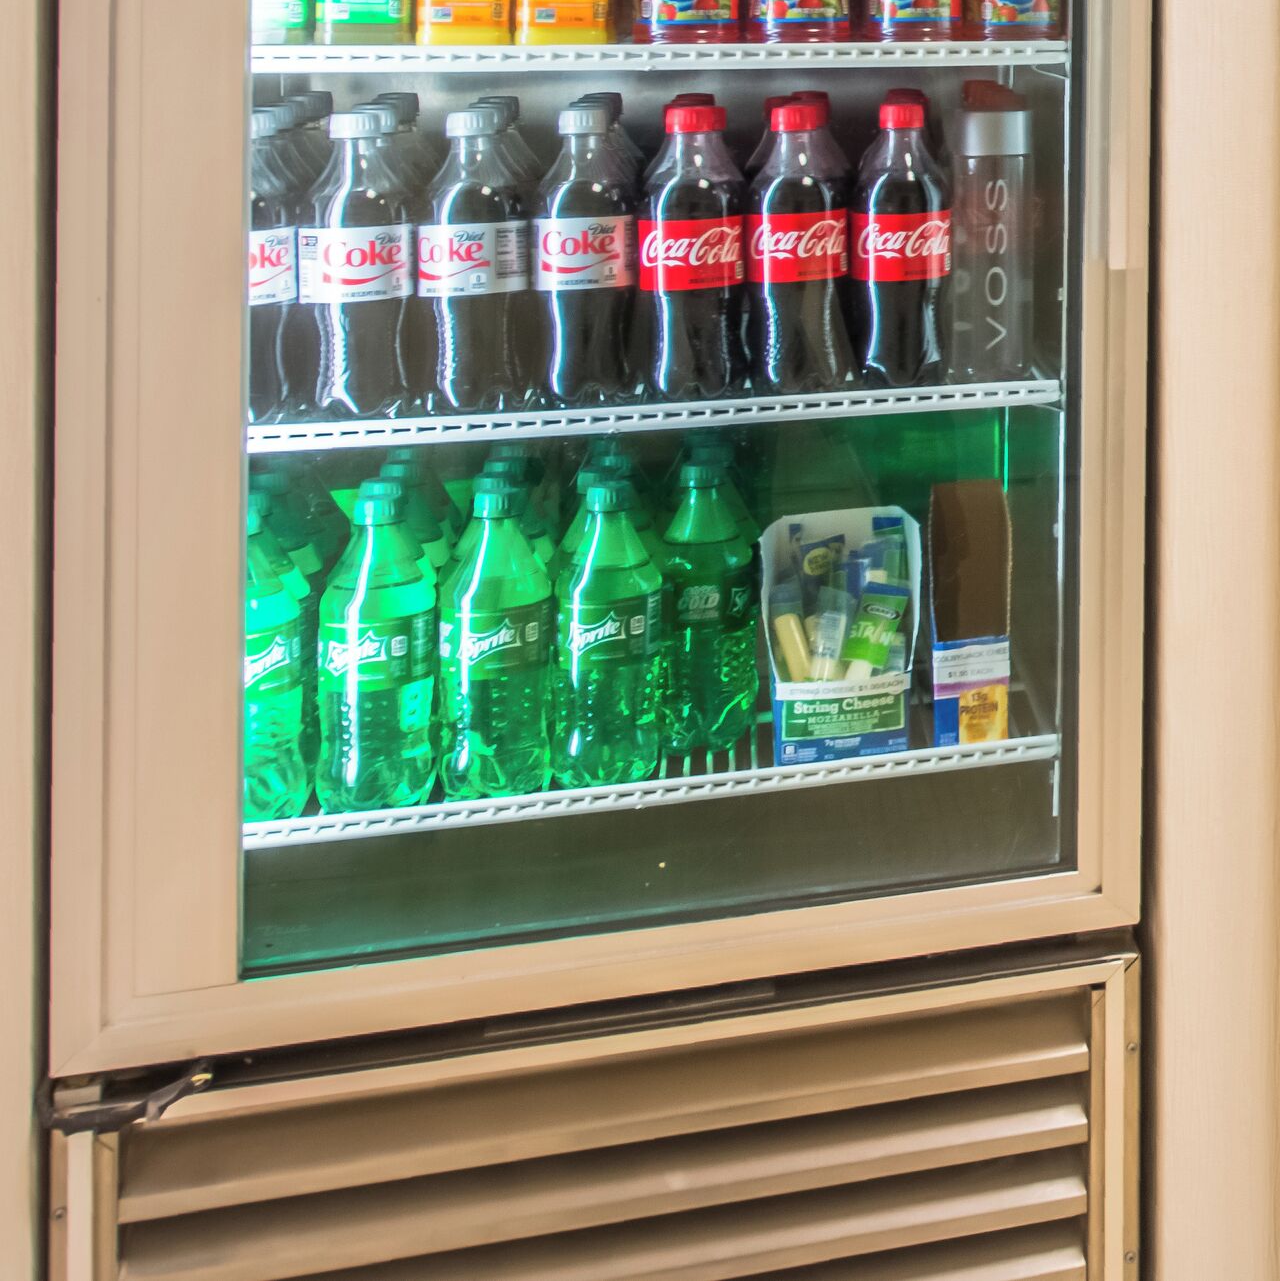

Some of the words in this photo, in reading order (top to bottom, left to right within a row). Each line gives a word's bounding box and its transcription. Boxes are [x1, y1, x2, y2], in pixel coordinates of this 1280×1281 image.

[454, 230, 485, 243] Diet
[542, 229, 616, 256] Coke
[588, 223, 616, 236] Diet
[752, 220, 848, 260] Coca-Cola
[858, 221, 951, 260] Coca-Cola
[250, 243, 289, 270] ke
[324, 240, 401, 268] Coke
[418, 237, 484, 264] Coke
[642, 227, 742, 269] Coca-Cola
[984, 177, 1008, 351] VOSS
[466, 627, 516, 658] Sprite
[794, 701, 840, 715] String
[842, 695, 895, 711] Cheese
